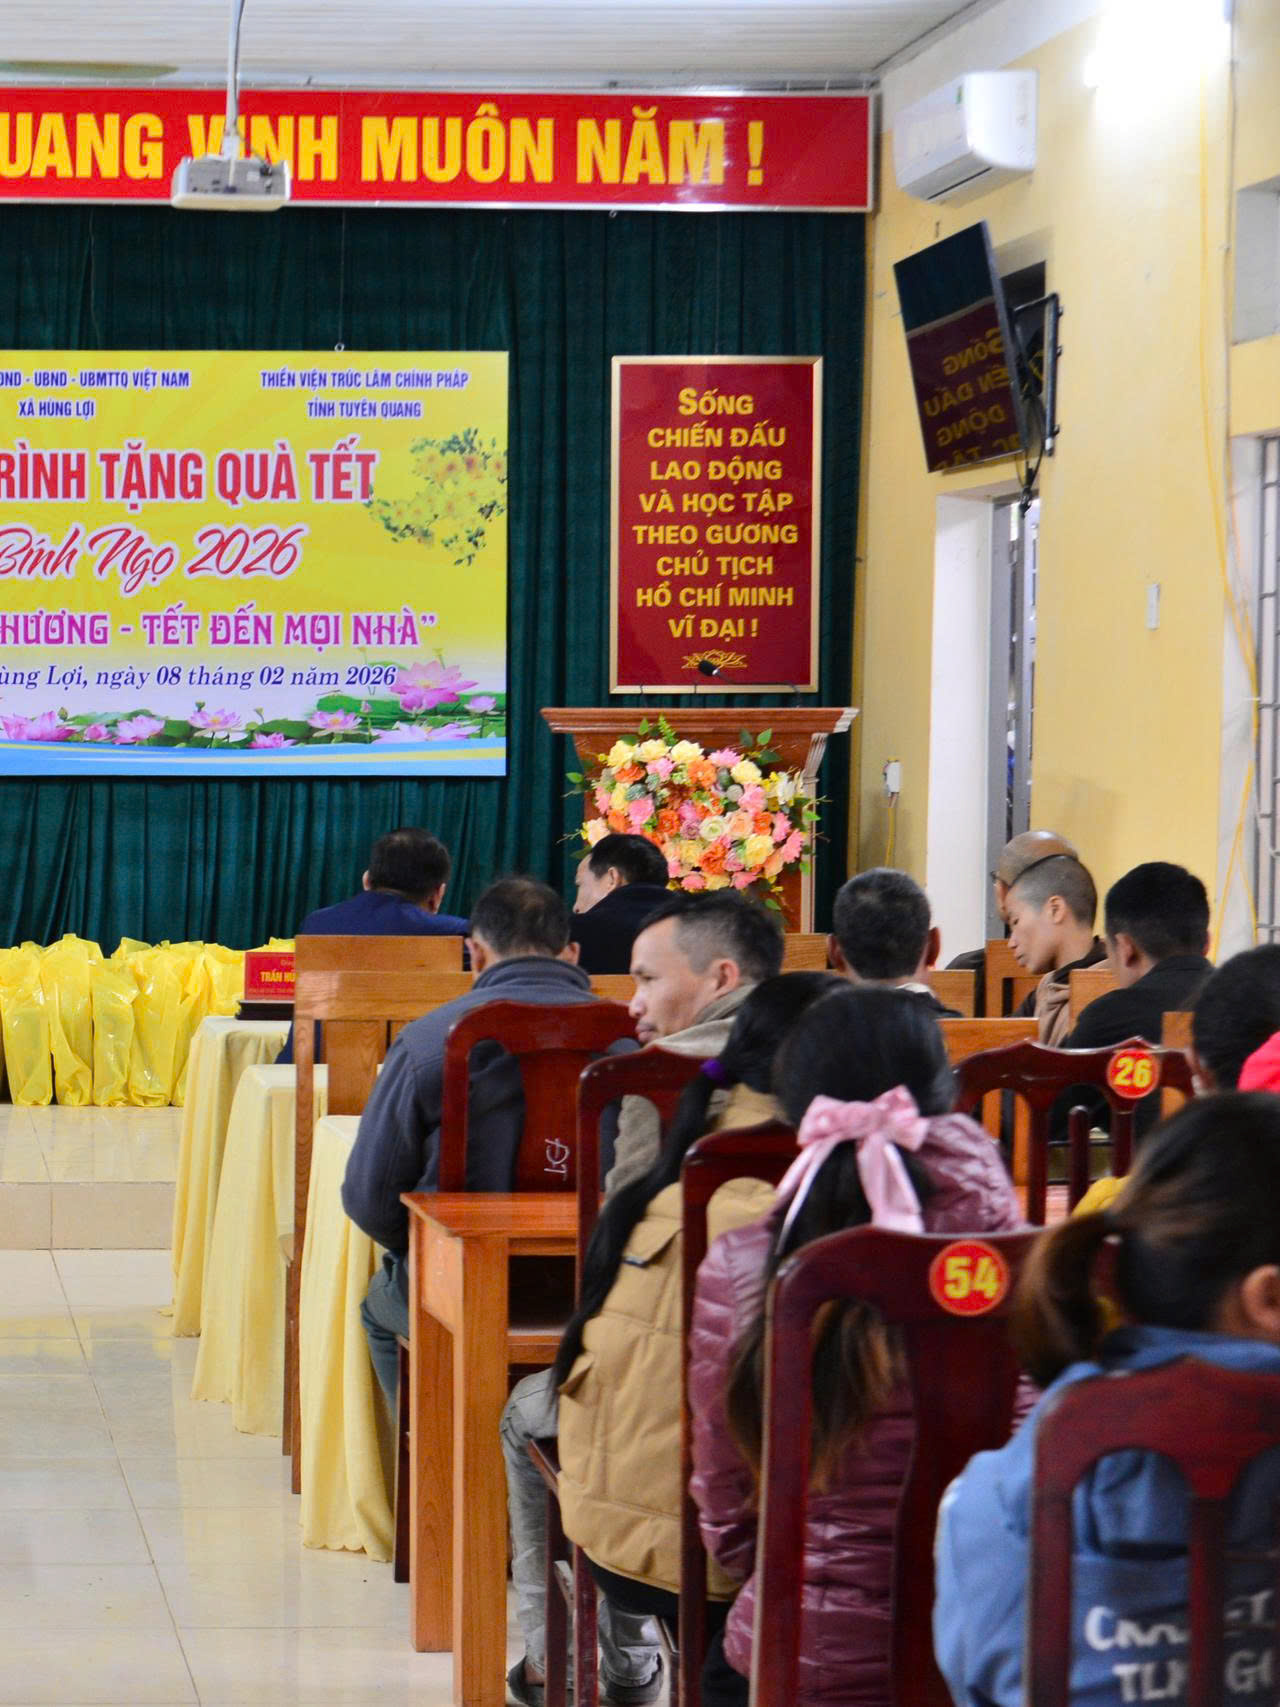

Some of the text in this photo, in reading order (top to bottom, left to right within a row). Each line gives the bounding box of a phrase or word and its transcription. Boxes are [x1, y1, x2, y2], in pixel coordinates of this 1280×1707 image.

[361, 103, 554, 184] MUÔN
[576, 105, 724, 186] NĂM
[746, 120, 764, 186] !
[34, 371, 67, 387] UBND
[80, 371, 129, 388] UBMTTQ
[133, 368, 157, 391] VIỆT
[161, 371, 190, 387] NAM
[19, 397, 95, 420] XÃ HÙNG LỢI
[307, 397, 421, 418] TỈNH TUYÊN QUANG
[678, 387, 754, 416] SỐNG
[647, 419, 787, 448] CHIẾN ĐẤU
[99, 441, 203, 510] TẶNG
[217, 439, 297, 506] QUÀ
[309, 436, 376, 500] TẾT
[650, 455, 782, 485] LAO ĐỘNG
[638, 488, 794, 517] VÀ HỌC TẬP
[632, 524, 799, 545] THEO GƯƠNG
[88, 527, 175, 594] Ngọ
[187, 527, 305, 577] 2026
[656, 549, 774, 581] CHỦ TỊCH
[636, 580, 794, 608] HỒ CHÍ MINH
[142, 602, 200, 645] TẾT
[209, 602, 272, 645] ĐẾN
[283, 614, 340, 652] MỌI
[668, 614, 696, 638] VĨ
[700, 618, 744, 642] ĐẠI
[46, 665, 90, 691] Lợi,
[95, 666, 151, 690] ngày
[156, 665, 182, 686] 08
[188, 665, 253, 690] tháng
[259, 665, 283, 686] 02
[290, 667, 339, 686] năm
[344, 666, 396, 686] 2026
[1113, 1056, 1152, 1088] 26
[943, 1256, 1003, 1299] 54
